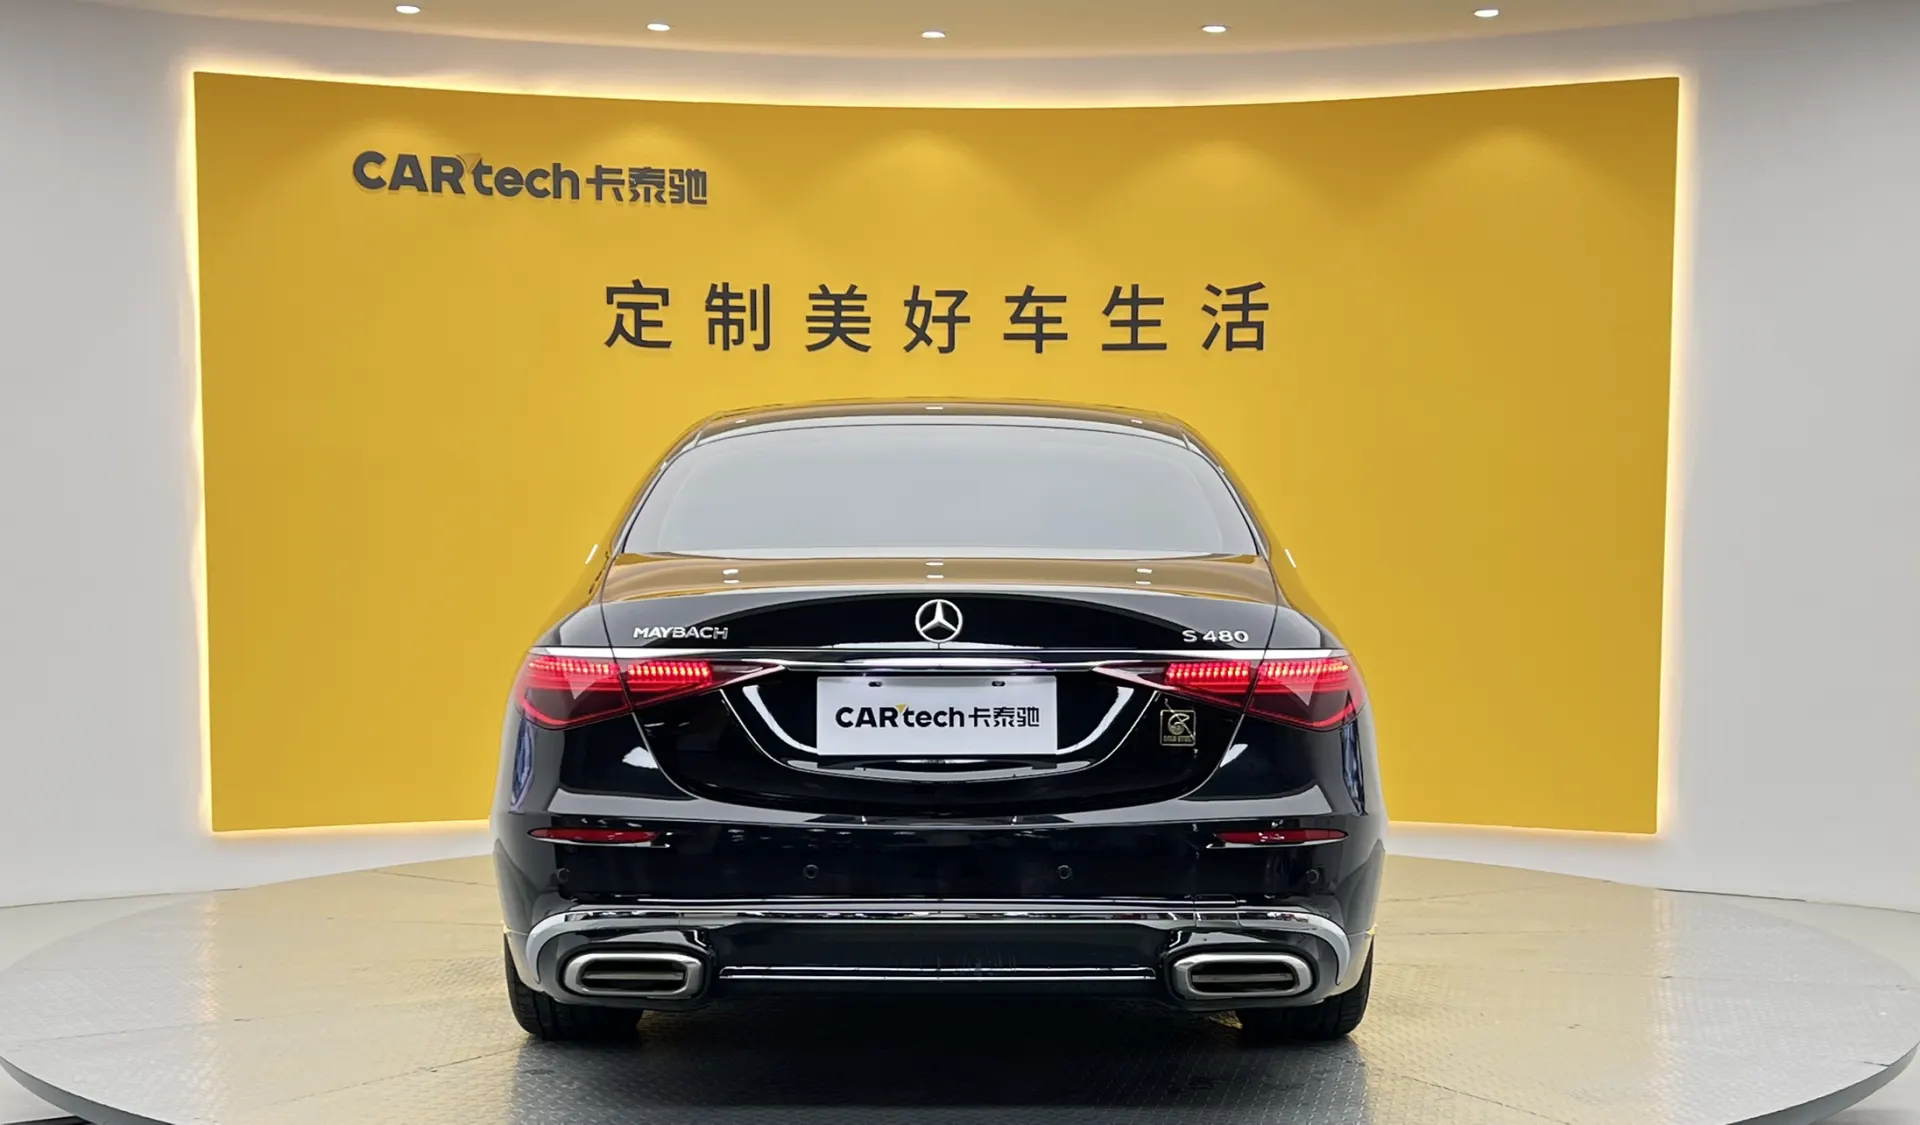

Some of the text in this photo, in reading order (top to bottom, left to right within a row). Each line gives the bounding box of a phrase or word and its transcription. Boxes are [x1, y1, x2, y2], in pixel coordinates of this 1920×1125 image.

[352, 150, 707, 205] CARtech 卡泰驰
[604, 279, 1269, 354] 定制美好车生活
[633, 626, 728, 639] MAYBACH
[1182, 630, 1249, 643] S 480
[835, 706, 1040, 728] CARtech 卡泰驰
